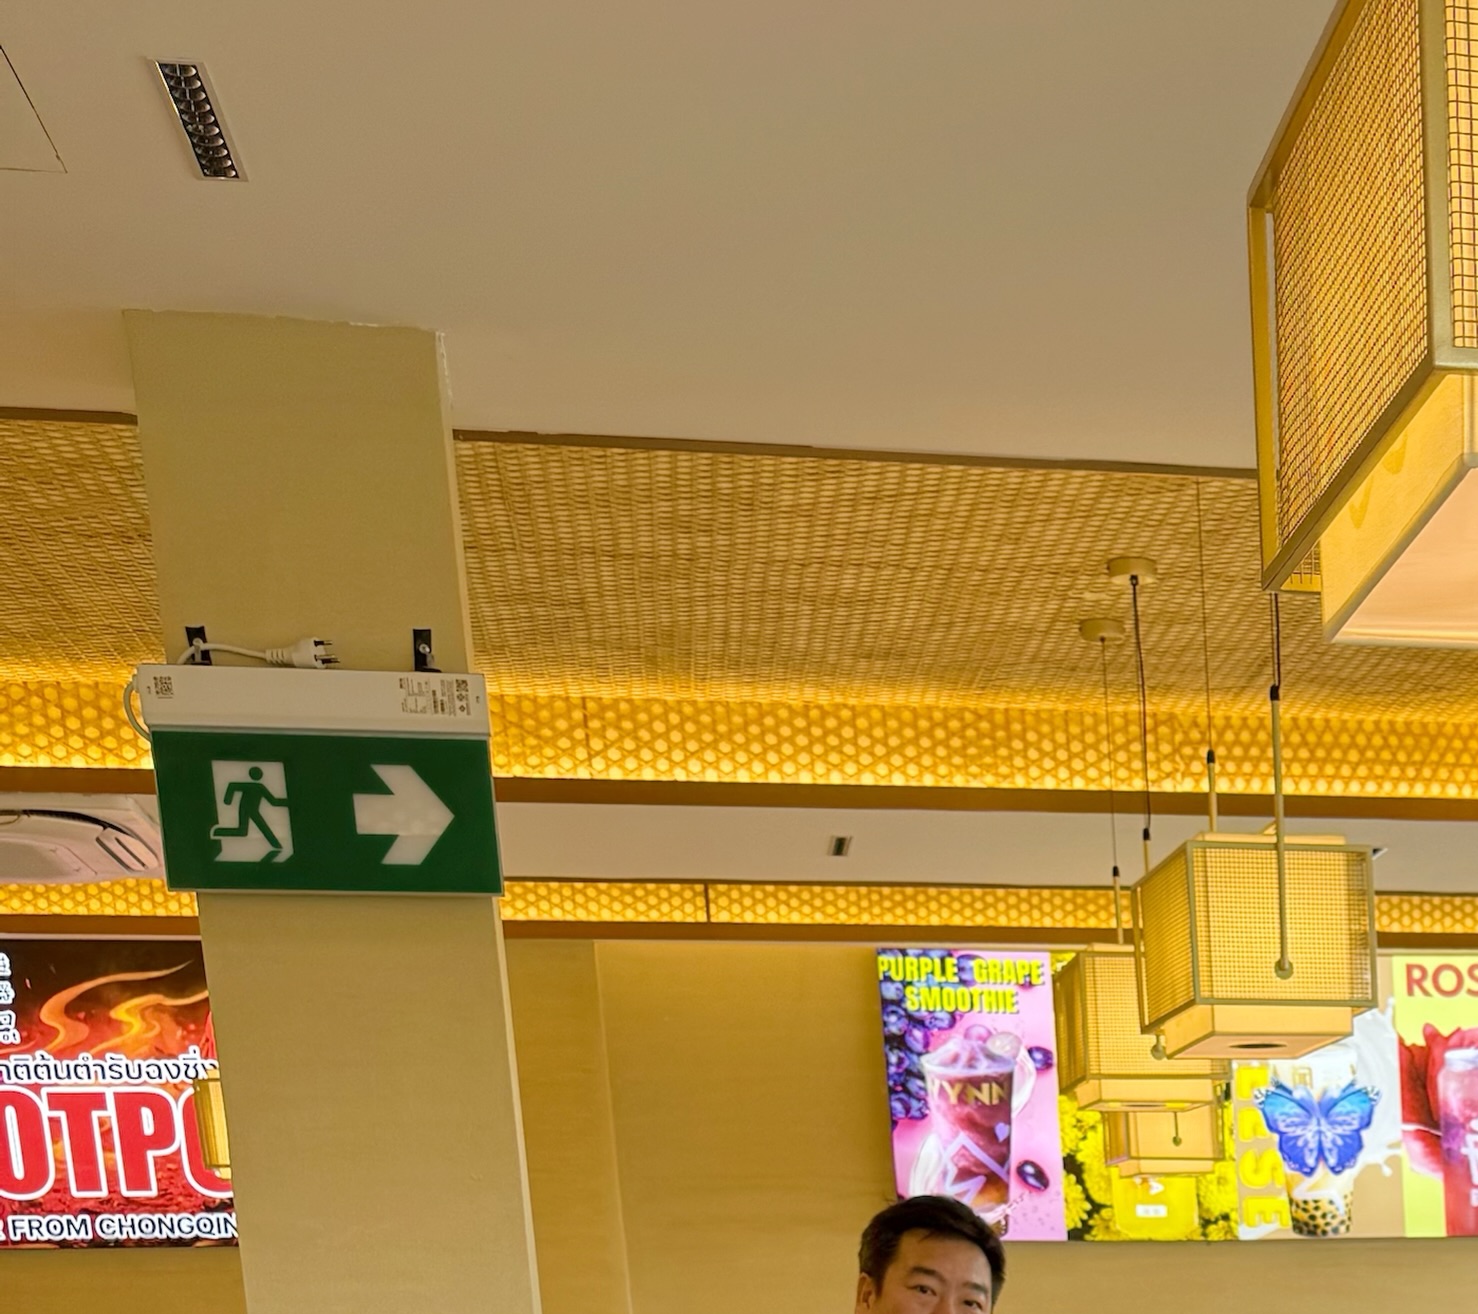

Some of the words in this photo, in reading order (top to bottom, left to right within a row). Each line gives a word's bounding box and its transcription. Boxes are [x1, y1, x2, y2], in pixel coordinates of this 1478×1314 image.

[877, 955, 960, 983] PURPLE
[972, 957, 1044, 986] GRAPE
[905, 985, 1019, 1014] SMOOTHIE
[11, 1216, 91, 1239] FROM
